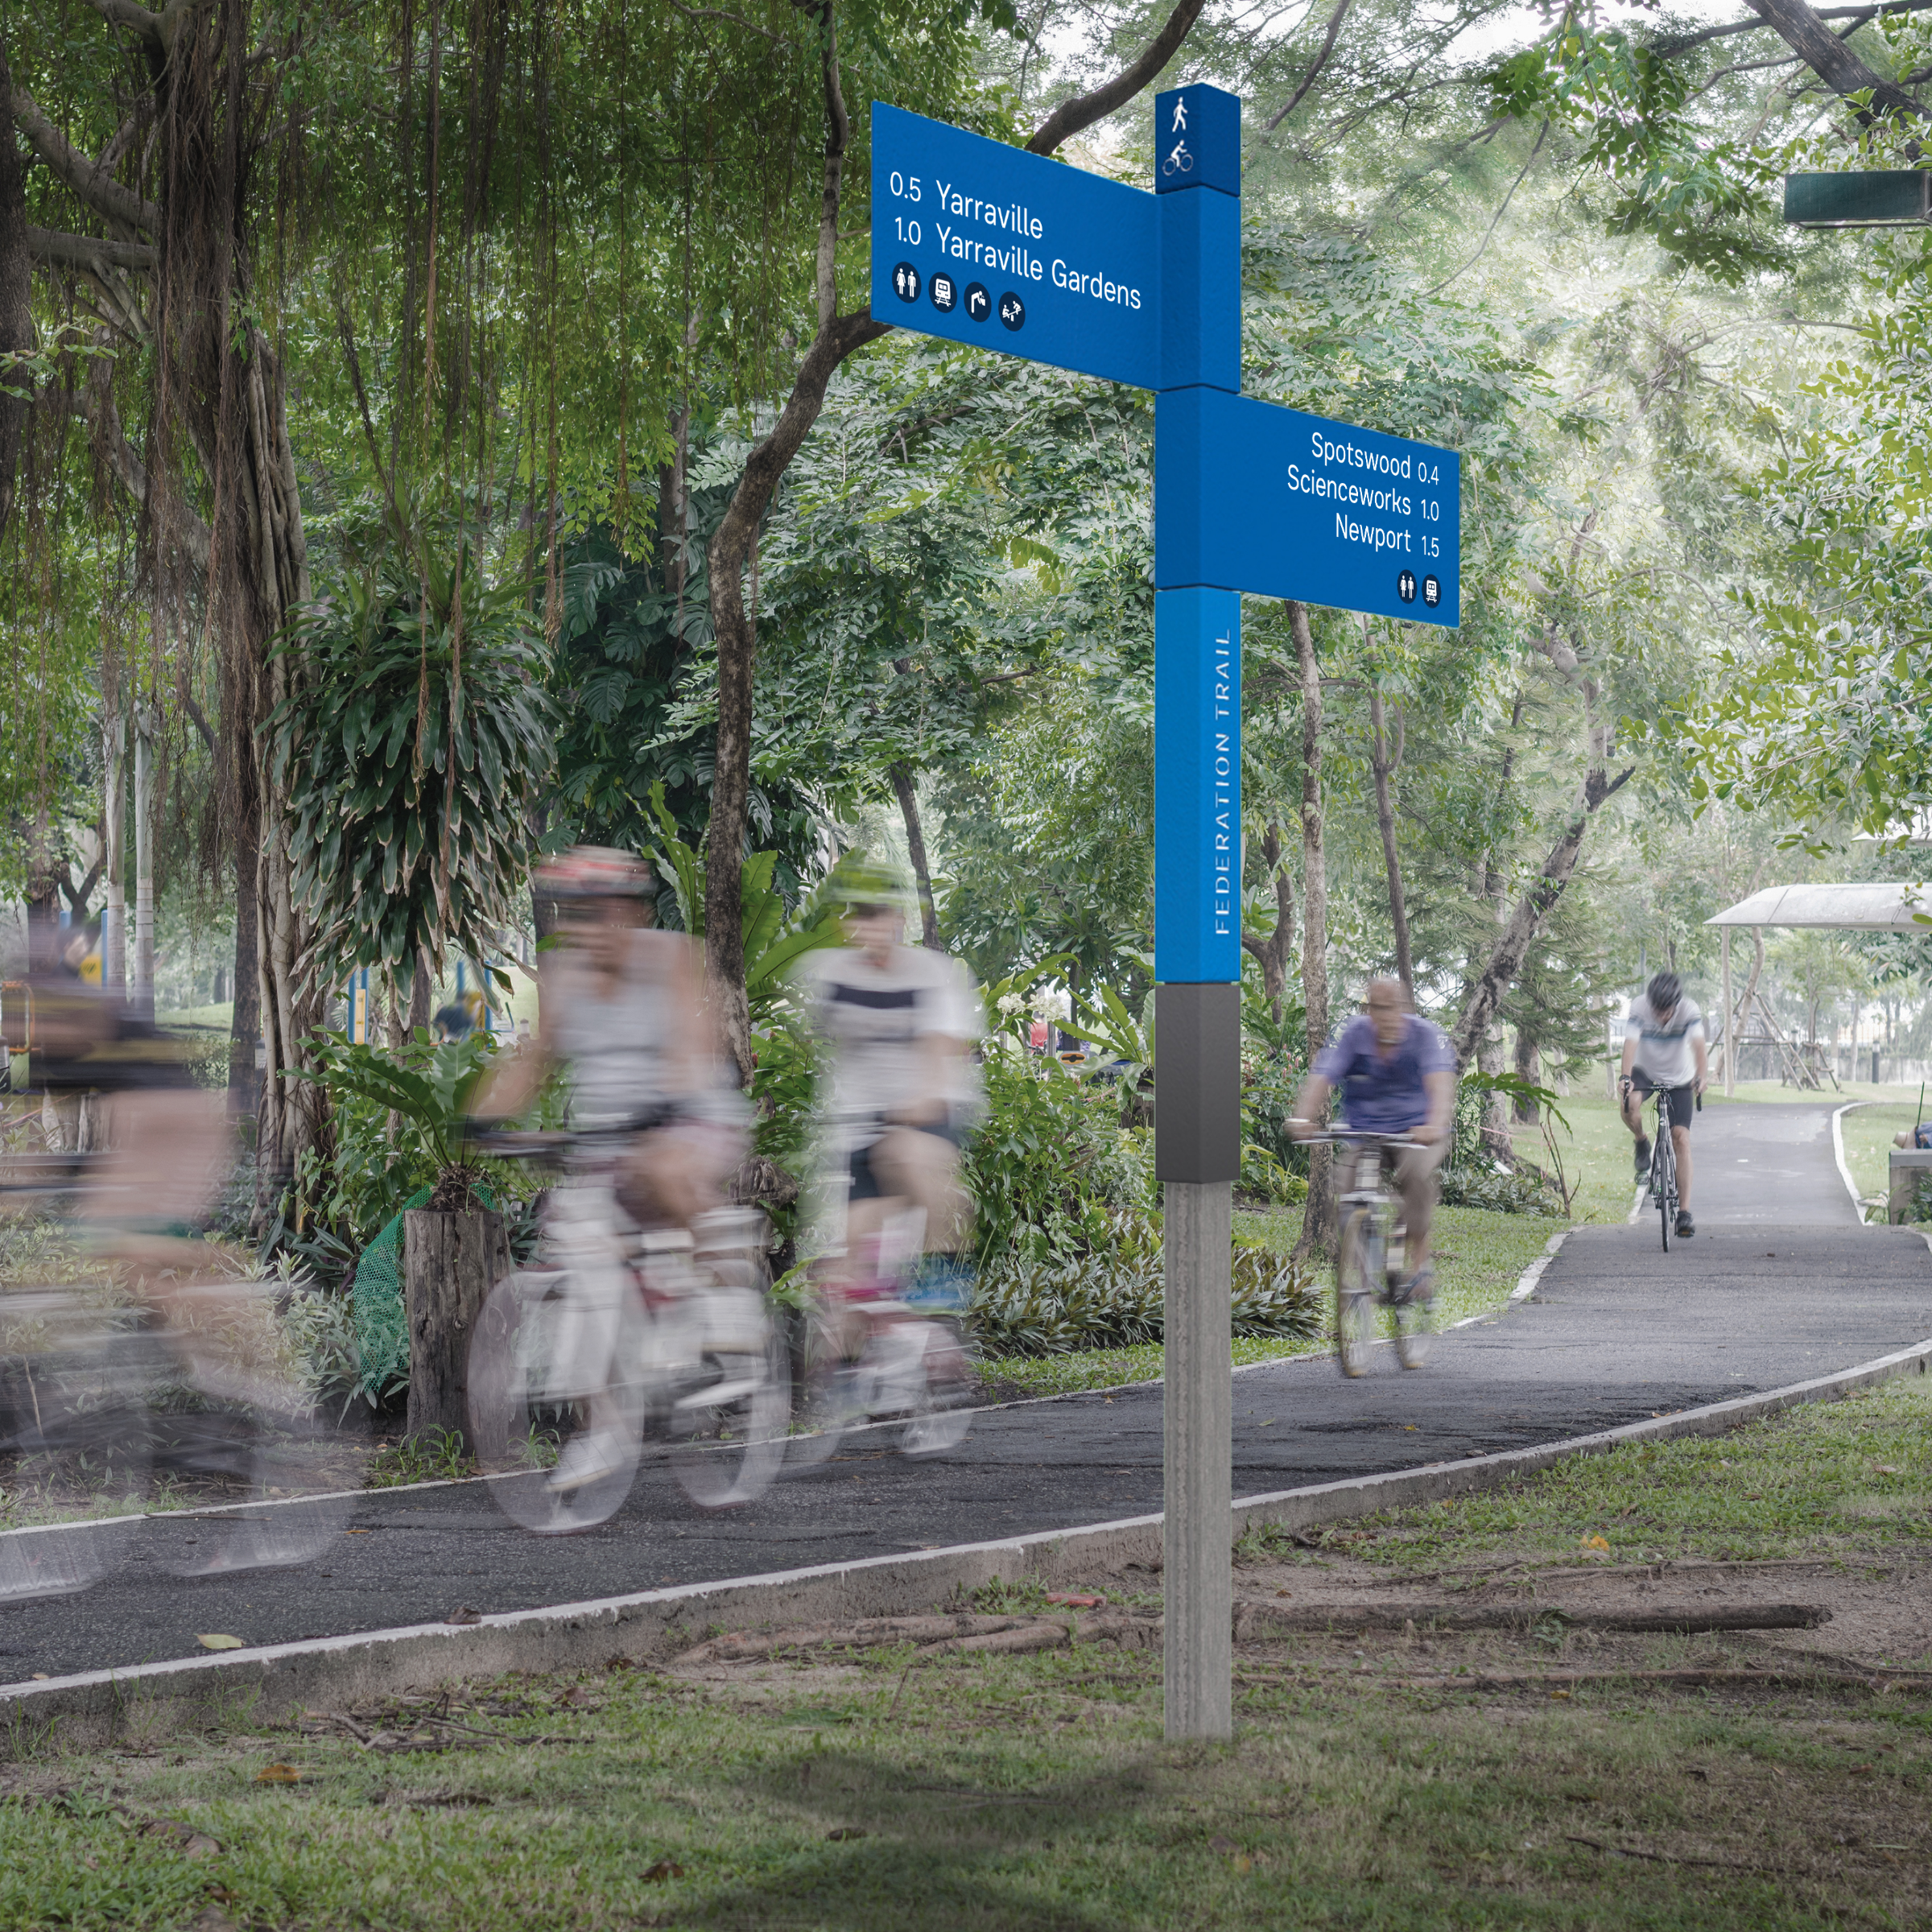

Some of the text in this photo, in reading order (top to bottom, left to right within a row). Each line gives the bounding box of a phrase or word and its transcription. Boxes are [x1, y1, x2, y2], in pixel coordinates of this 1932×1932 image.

[890, 171, 1043, 239] 0.5 Yarraville
[894, 217, 1141, 310] 1.0 Yarraville Gardens
[1311, 431, 1439, 485] Spotswood 0.4
[1287, 464, 1439, 522] Scienceworks 1.0
[1335, 512, 1439, 558] Newport 1.5
[1216, 630, 1229, 935] FEDERATION TRAIL
